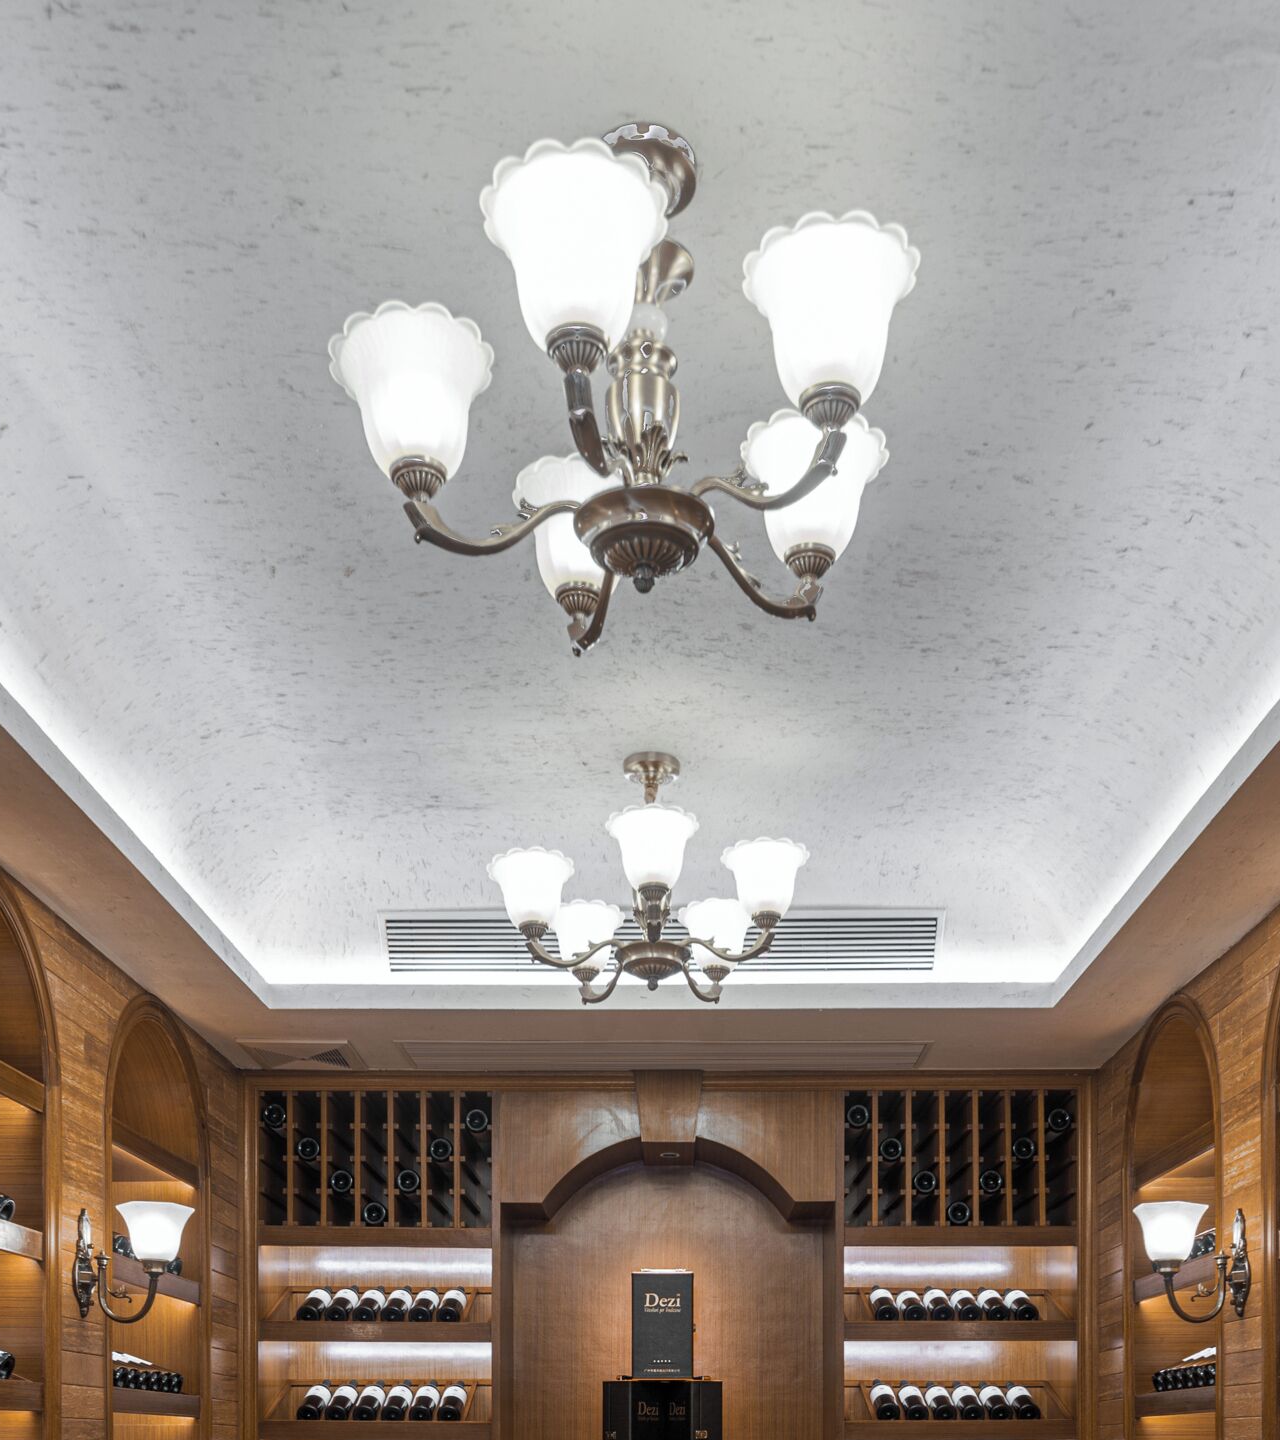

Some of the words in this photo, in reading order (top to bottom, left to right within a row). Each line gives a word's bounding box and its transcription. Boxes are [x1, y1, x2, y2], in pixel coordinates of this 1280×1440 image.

[644, 1292, 681, 1307] Dezi
[638, 1401, 659, 1416] Dezi
[669, 1401, 686, 1416] Dezi
